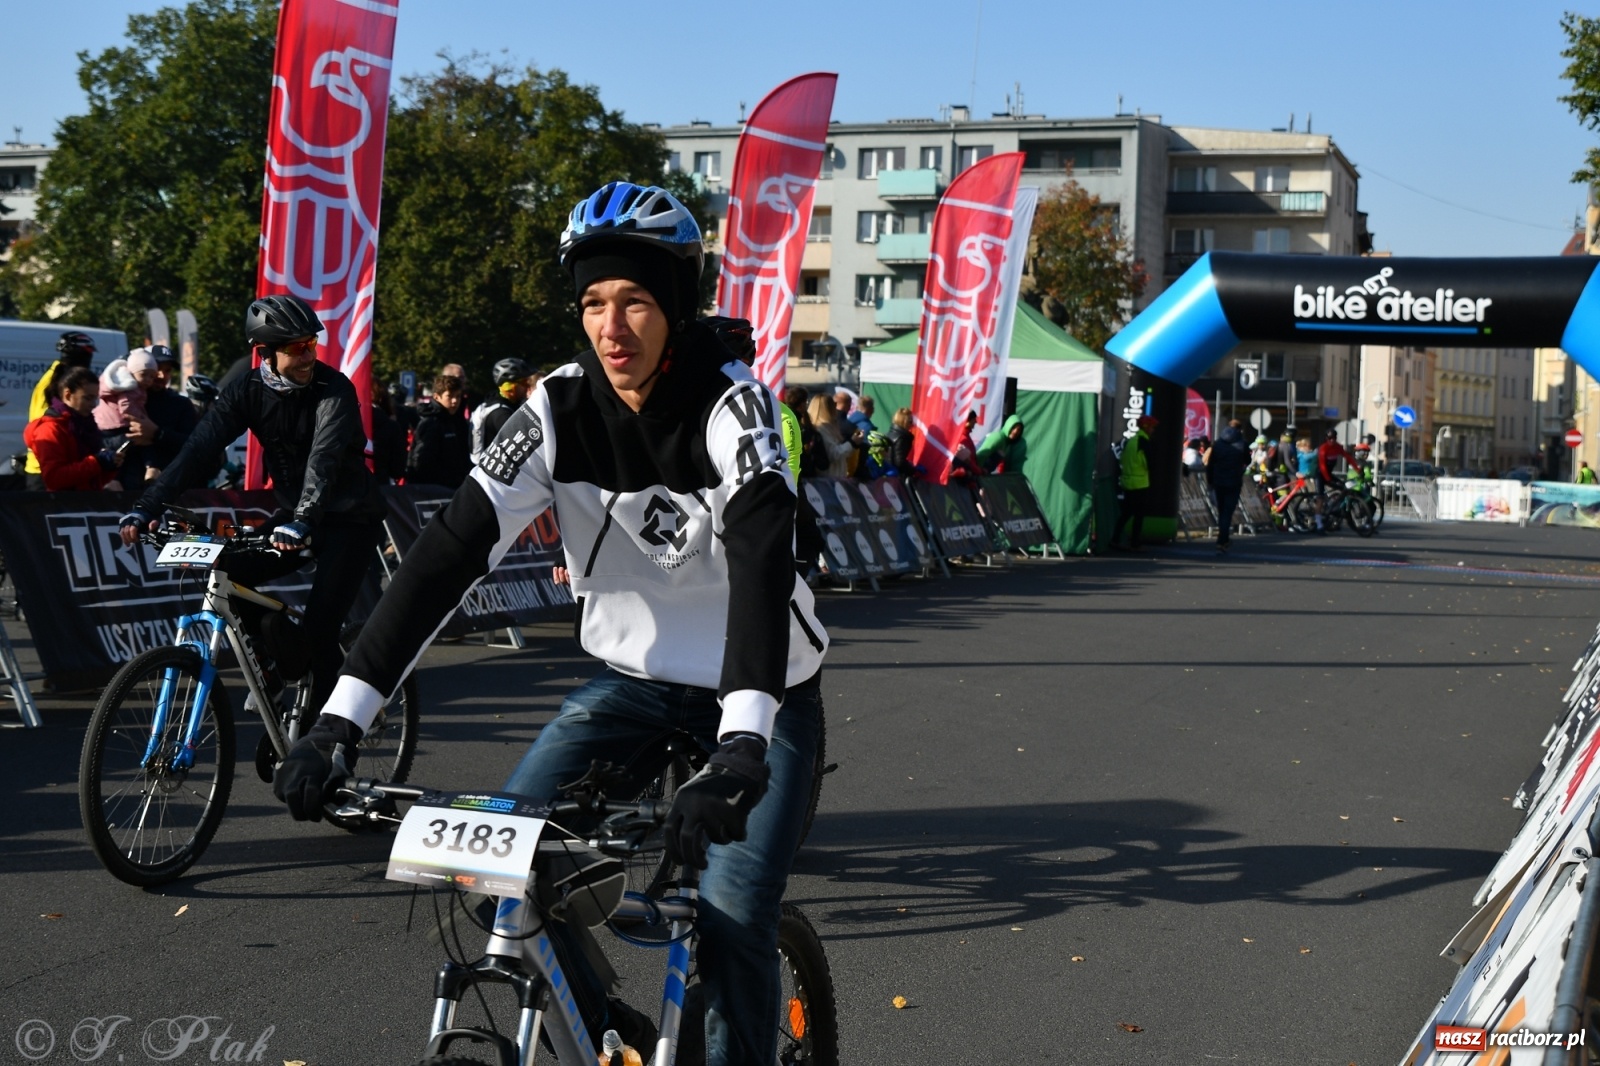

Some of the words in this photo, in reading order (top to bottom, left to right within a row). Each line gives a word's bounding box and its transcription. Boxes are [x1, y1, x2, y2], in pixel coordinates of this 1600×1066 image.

[1294, 284, 1368, 320] bike
[1376, 287, 1492, 322] atelier
[725, 385, 775, 430] W
[170, 546, 211, 558] 3173
[422, 819, 517, 858] 3183
